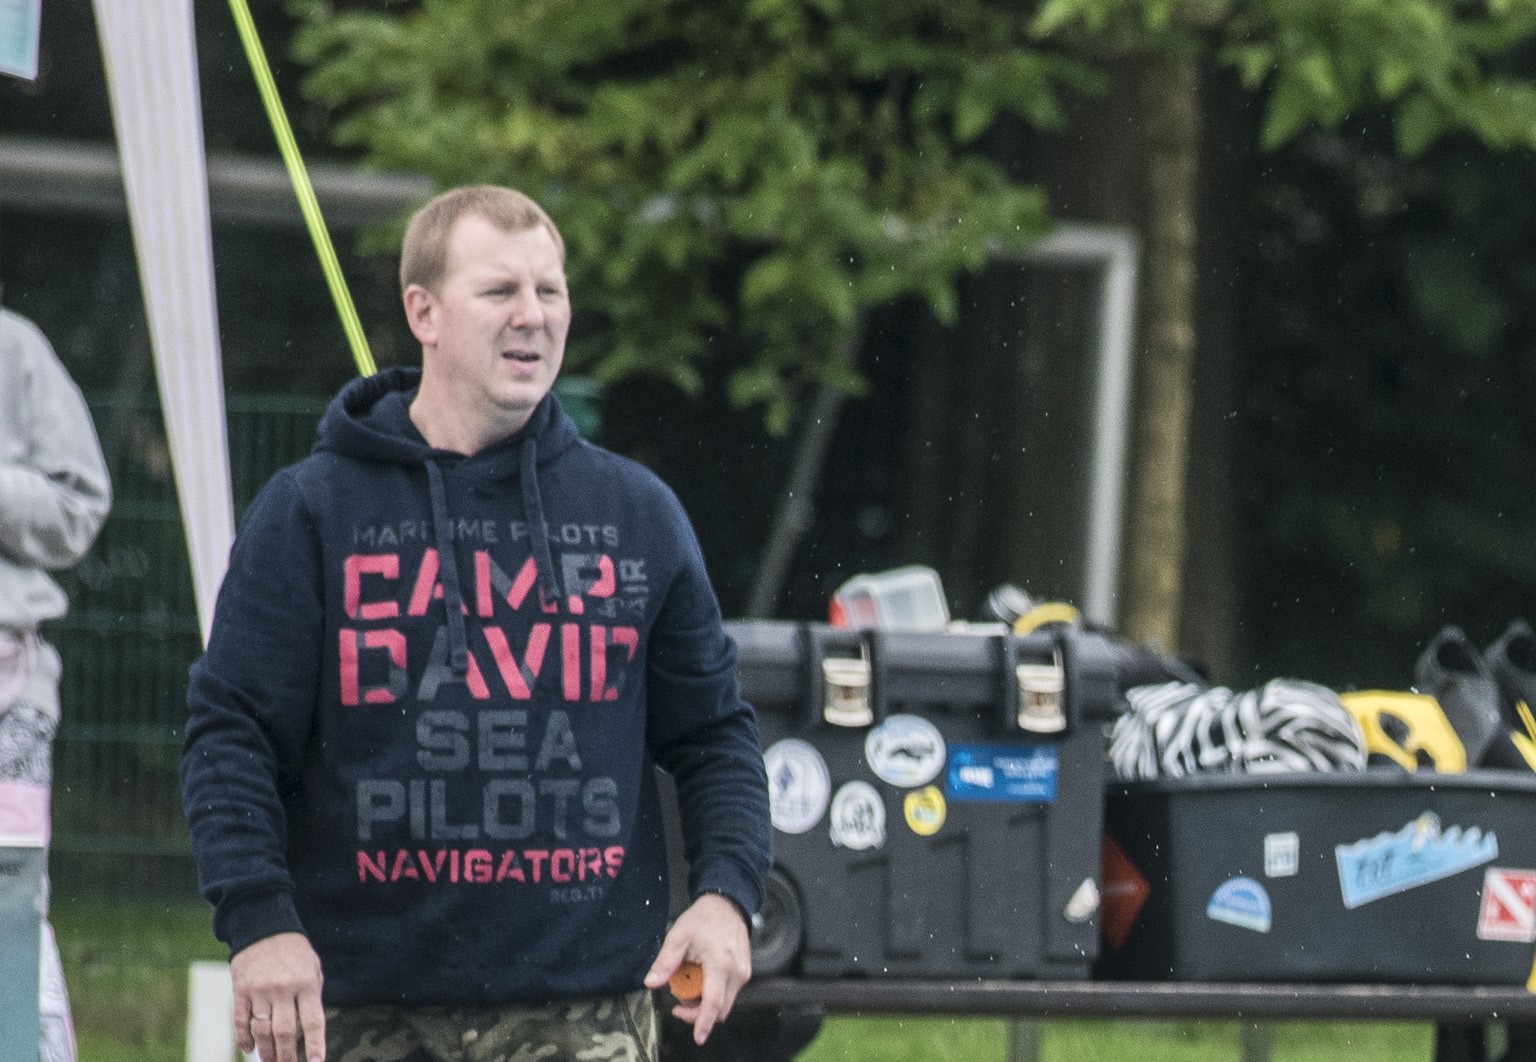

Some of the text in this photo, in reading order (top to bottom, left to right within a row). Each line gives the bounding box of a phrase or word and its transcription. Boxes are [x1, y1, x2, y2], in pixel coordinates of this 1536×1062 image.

[353, 519, 498, 547] MARIIME
[339, 623, 639, 706] DAVID
[416, 710, 583, 772] SEA
[357, 777, 622, 841] PILOTS
[357, 845, 625, 884] NAVIGATORS
